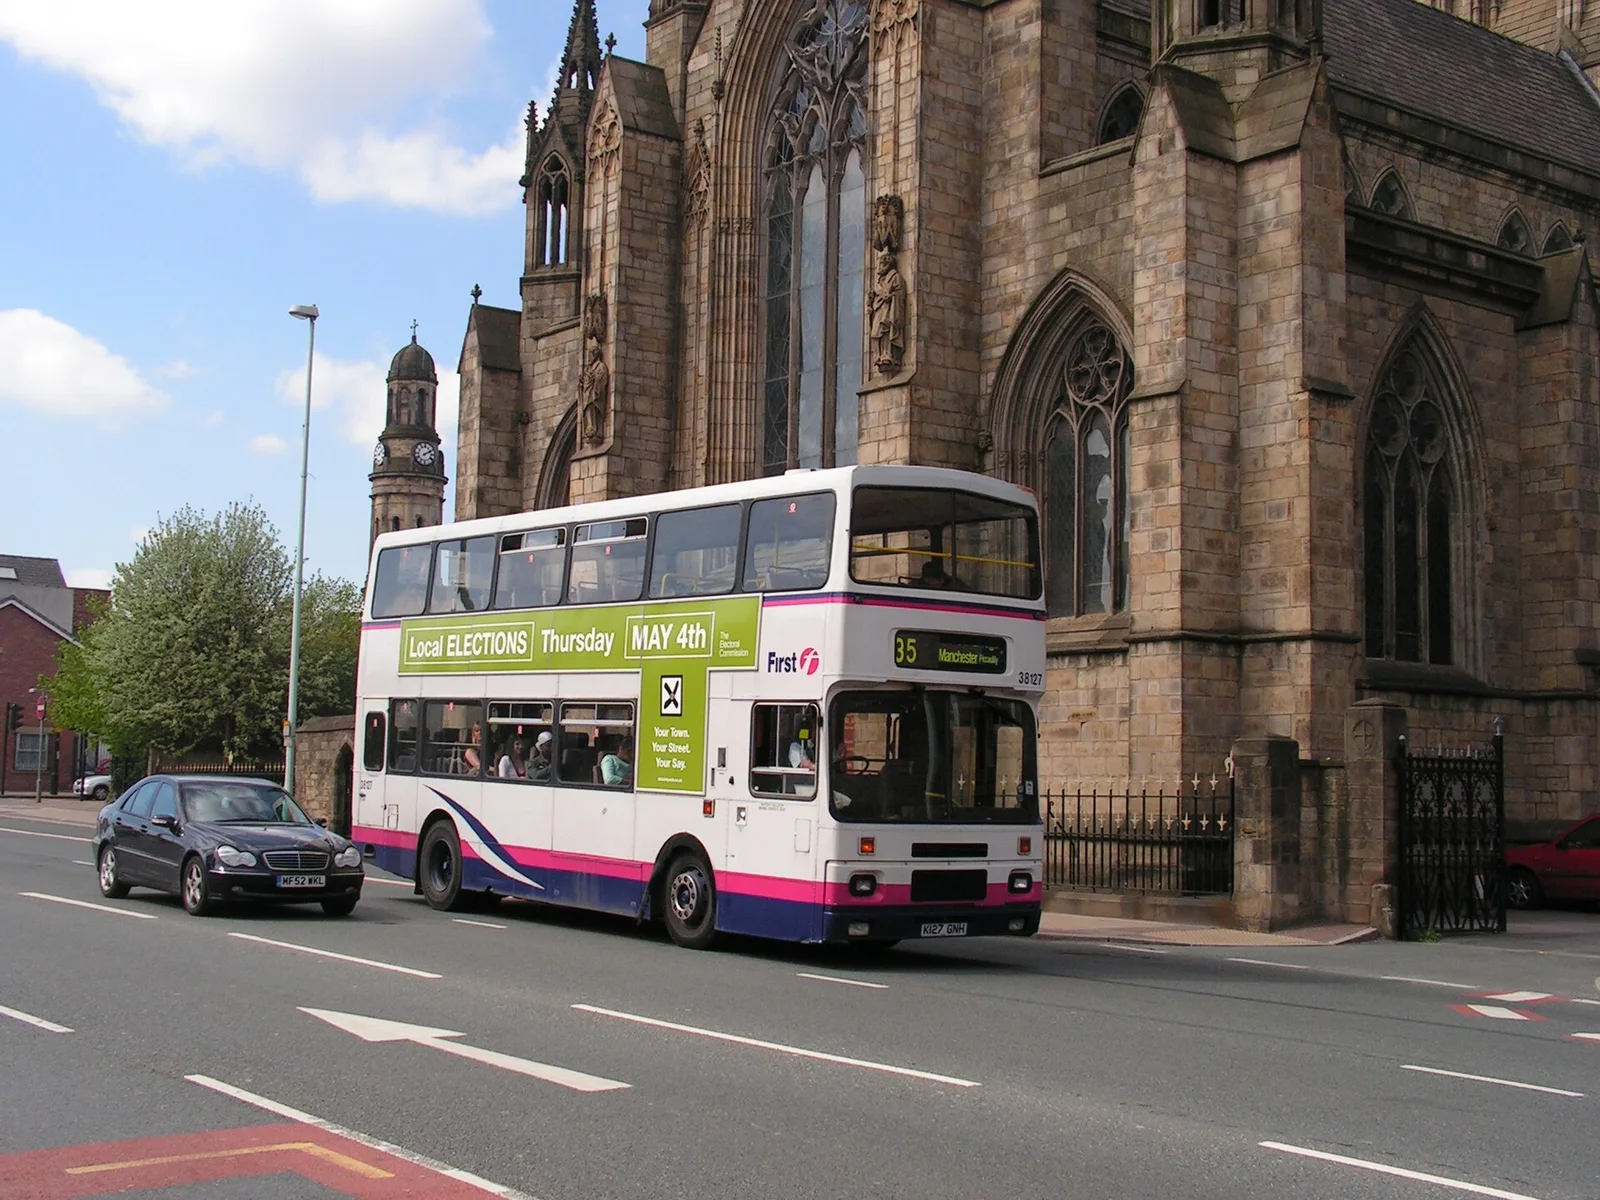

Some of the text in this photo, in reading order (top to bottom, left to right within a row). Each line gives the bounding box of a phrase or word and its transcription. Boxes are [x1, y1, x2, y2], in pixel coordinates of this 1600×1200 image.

[541, 627, 615, 657] Thursday
[631, 622, 707, 651] MAY 4th
[720, 631, 729, 640] The
[409, 630, 528, 658] Local ELECTIONS
[896, 637, 917, 664] 35
[768, 651, 797, 673] First
[938, 648, 978, 664] Manchester
[1018, 671, 1043, 686] 38127
[654, 726, 690, 738] Your Town.
[652, 741, 691, 754] Your Street.
[655, 757, 687, 771] Your Say.
[282, 876, 307, 886] MF52
[922, 924, 966, 935] K127 GNH
